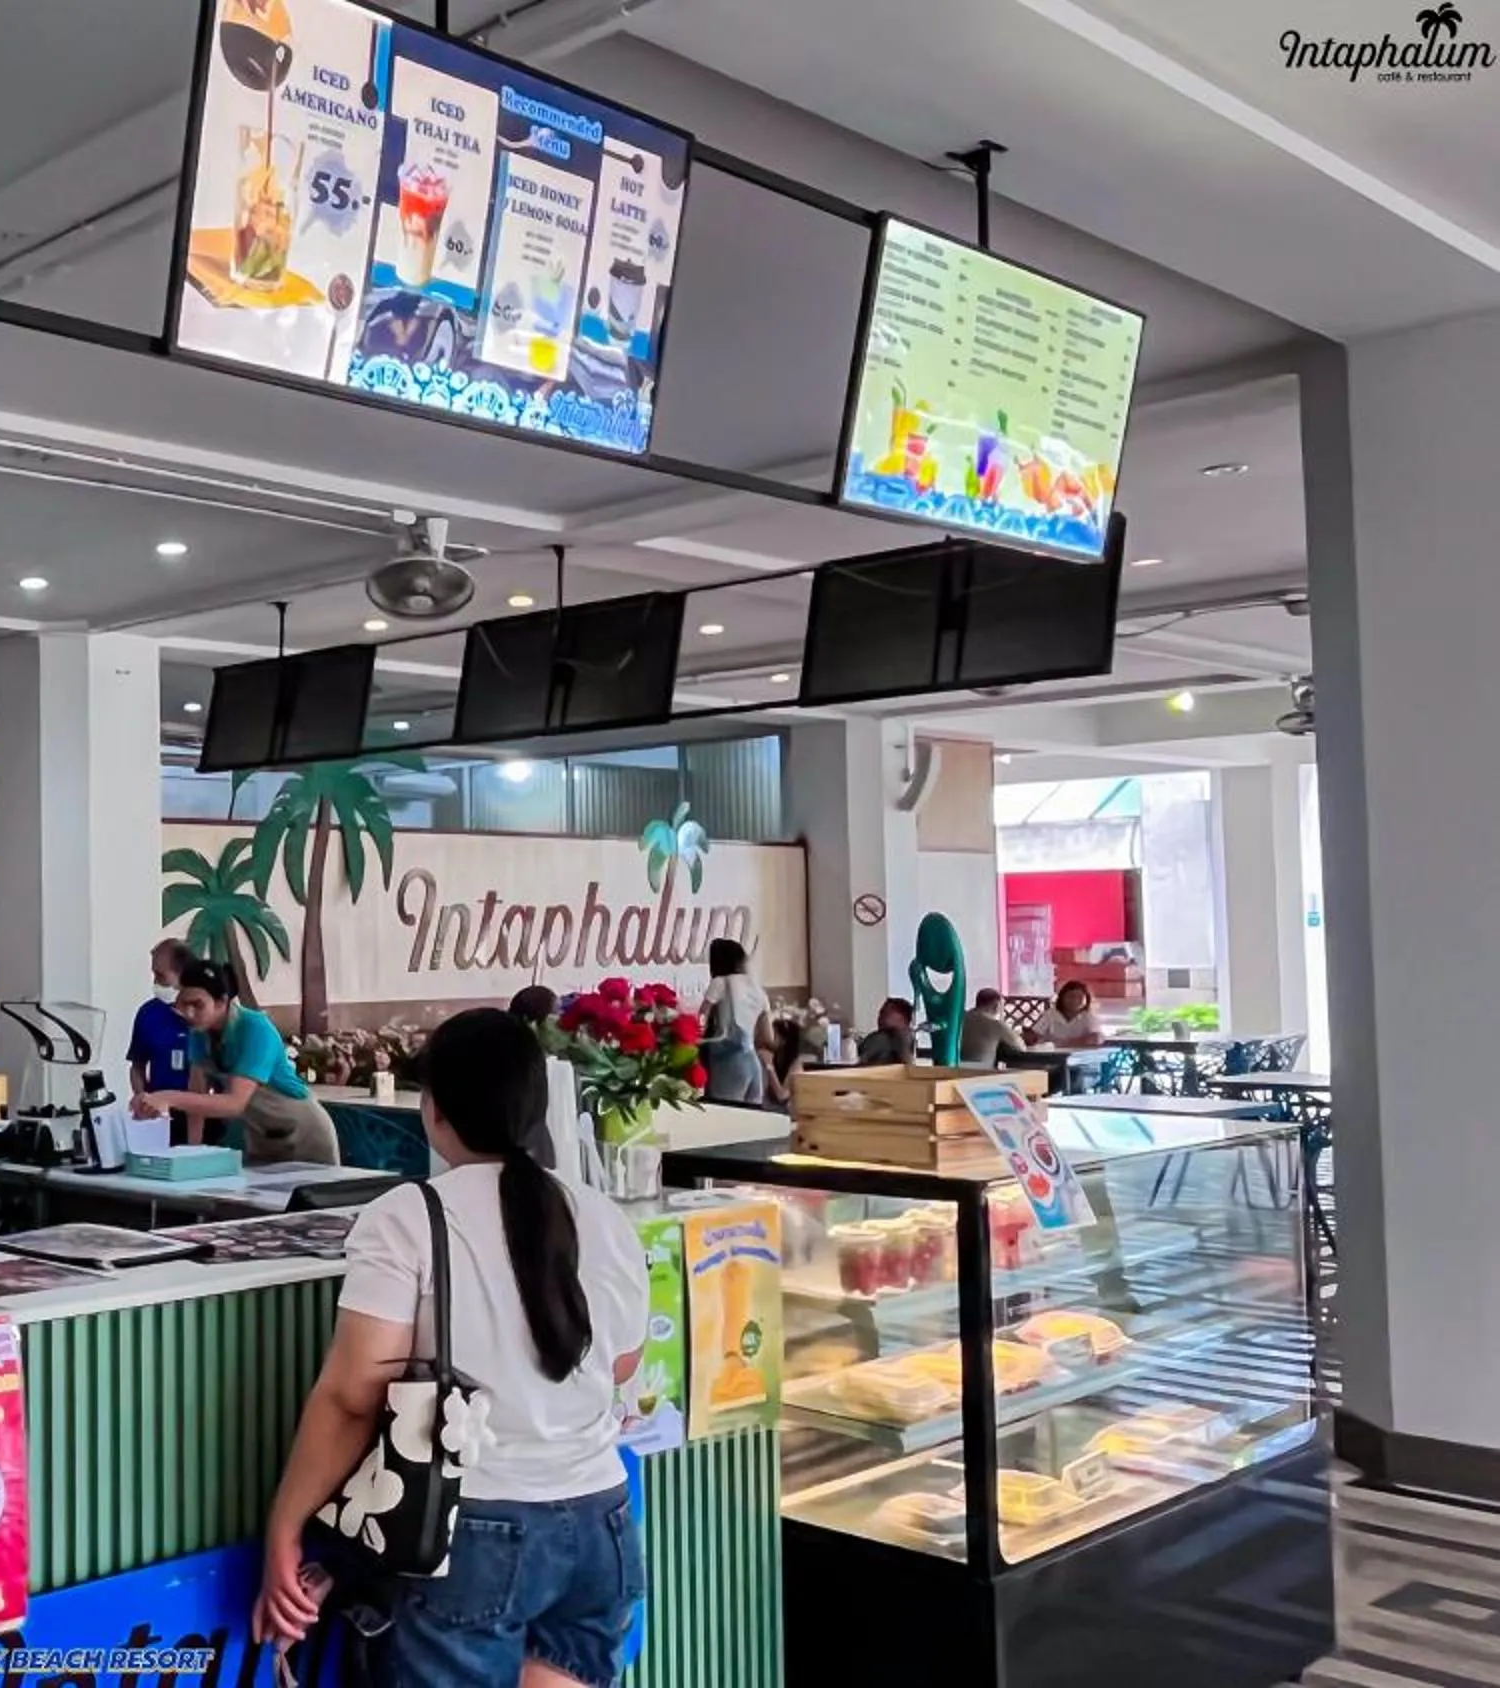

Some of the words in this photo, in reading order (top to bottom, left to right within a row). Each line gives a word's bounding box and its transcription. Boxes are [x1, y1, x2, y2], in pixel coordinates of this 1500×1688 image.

[312, 66, 350, 91] ICED
[281, 86, 378, 130] AMERICANO
[431, 97, 465, 122] ICED
[502, 87, 601, 141] Recommended
[413, 118, 450, 142] THAI
[453, 131, 481, 155] TEA
[508, 175, 537, 196] ICED
[620, 176, 645, 197] HOT
[511, 199, 554, 224] LEMON
